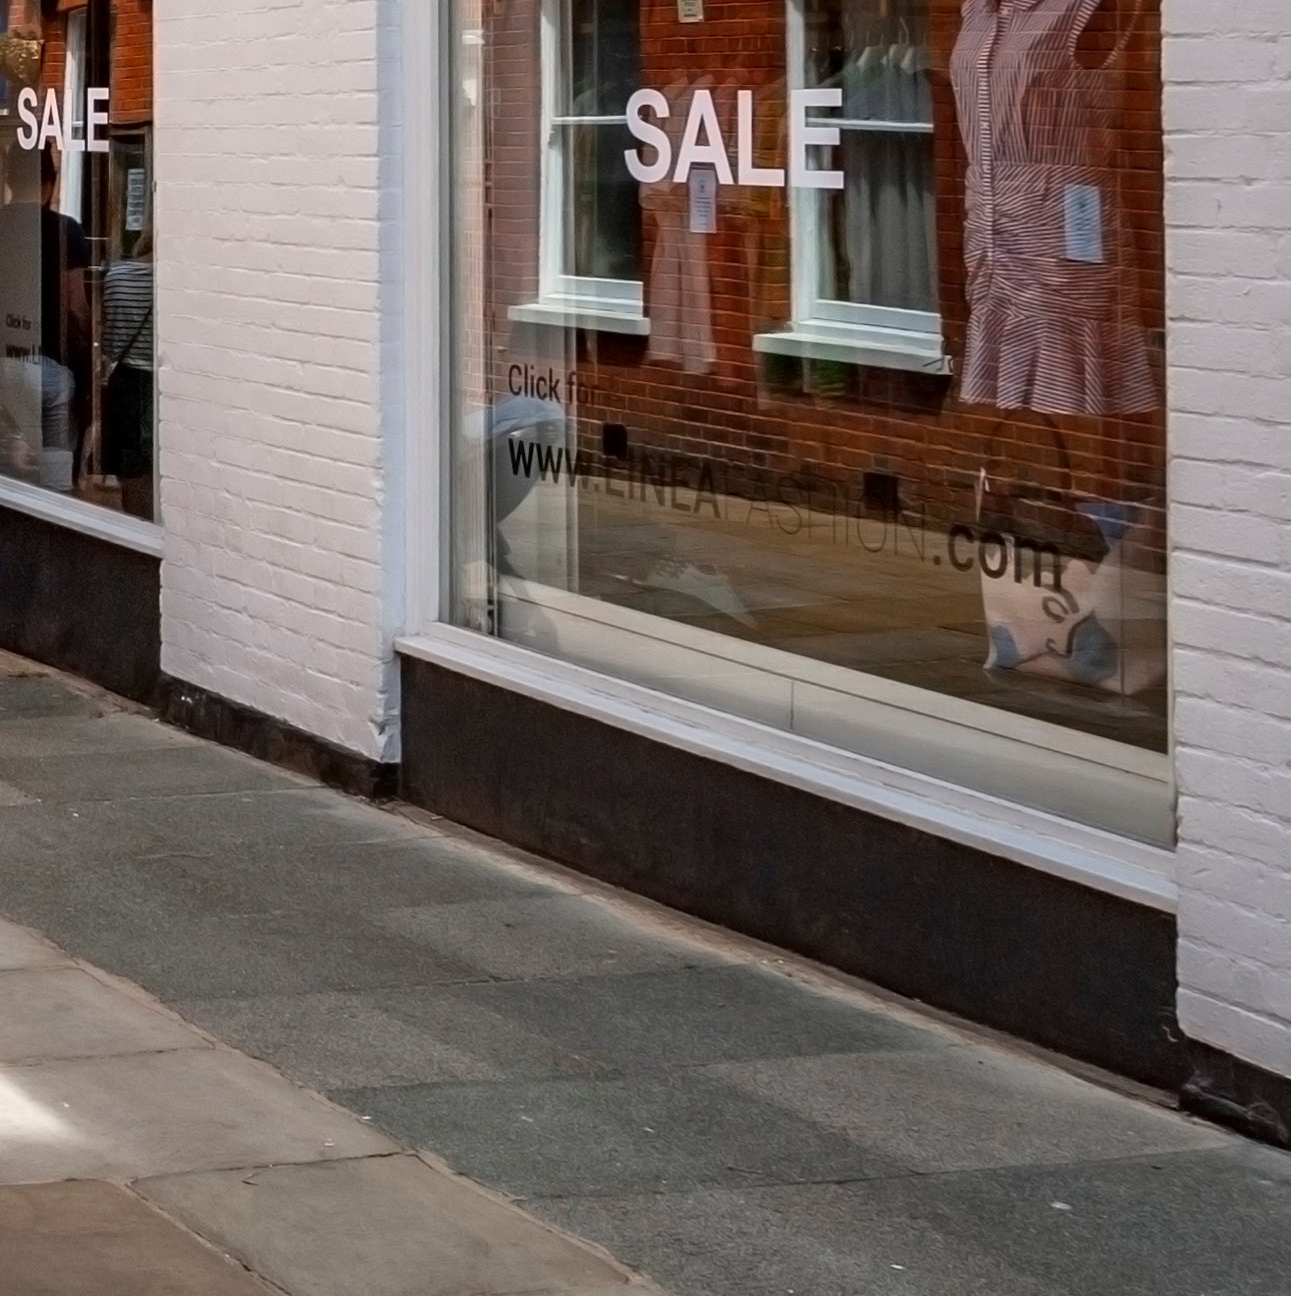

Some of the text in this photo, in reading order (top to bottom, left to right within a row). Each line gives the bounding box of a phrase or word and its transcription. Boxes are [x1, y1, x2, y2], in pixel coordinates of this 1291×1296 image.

[17, 87, 110, 152] SALE
[624, 88, 845, 190] SALE
[508, 364, 597, 405] Click for
